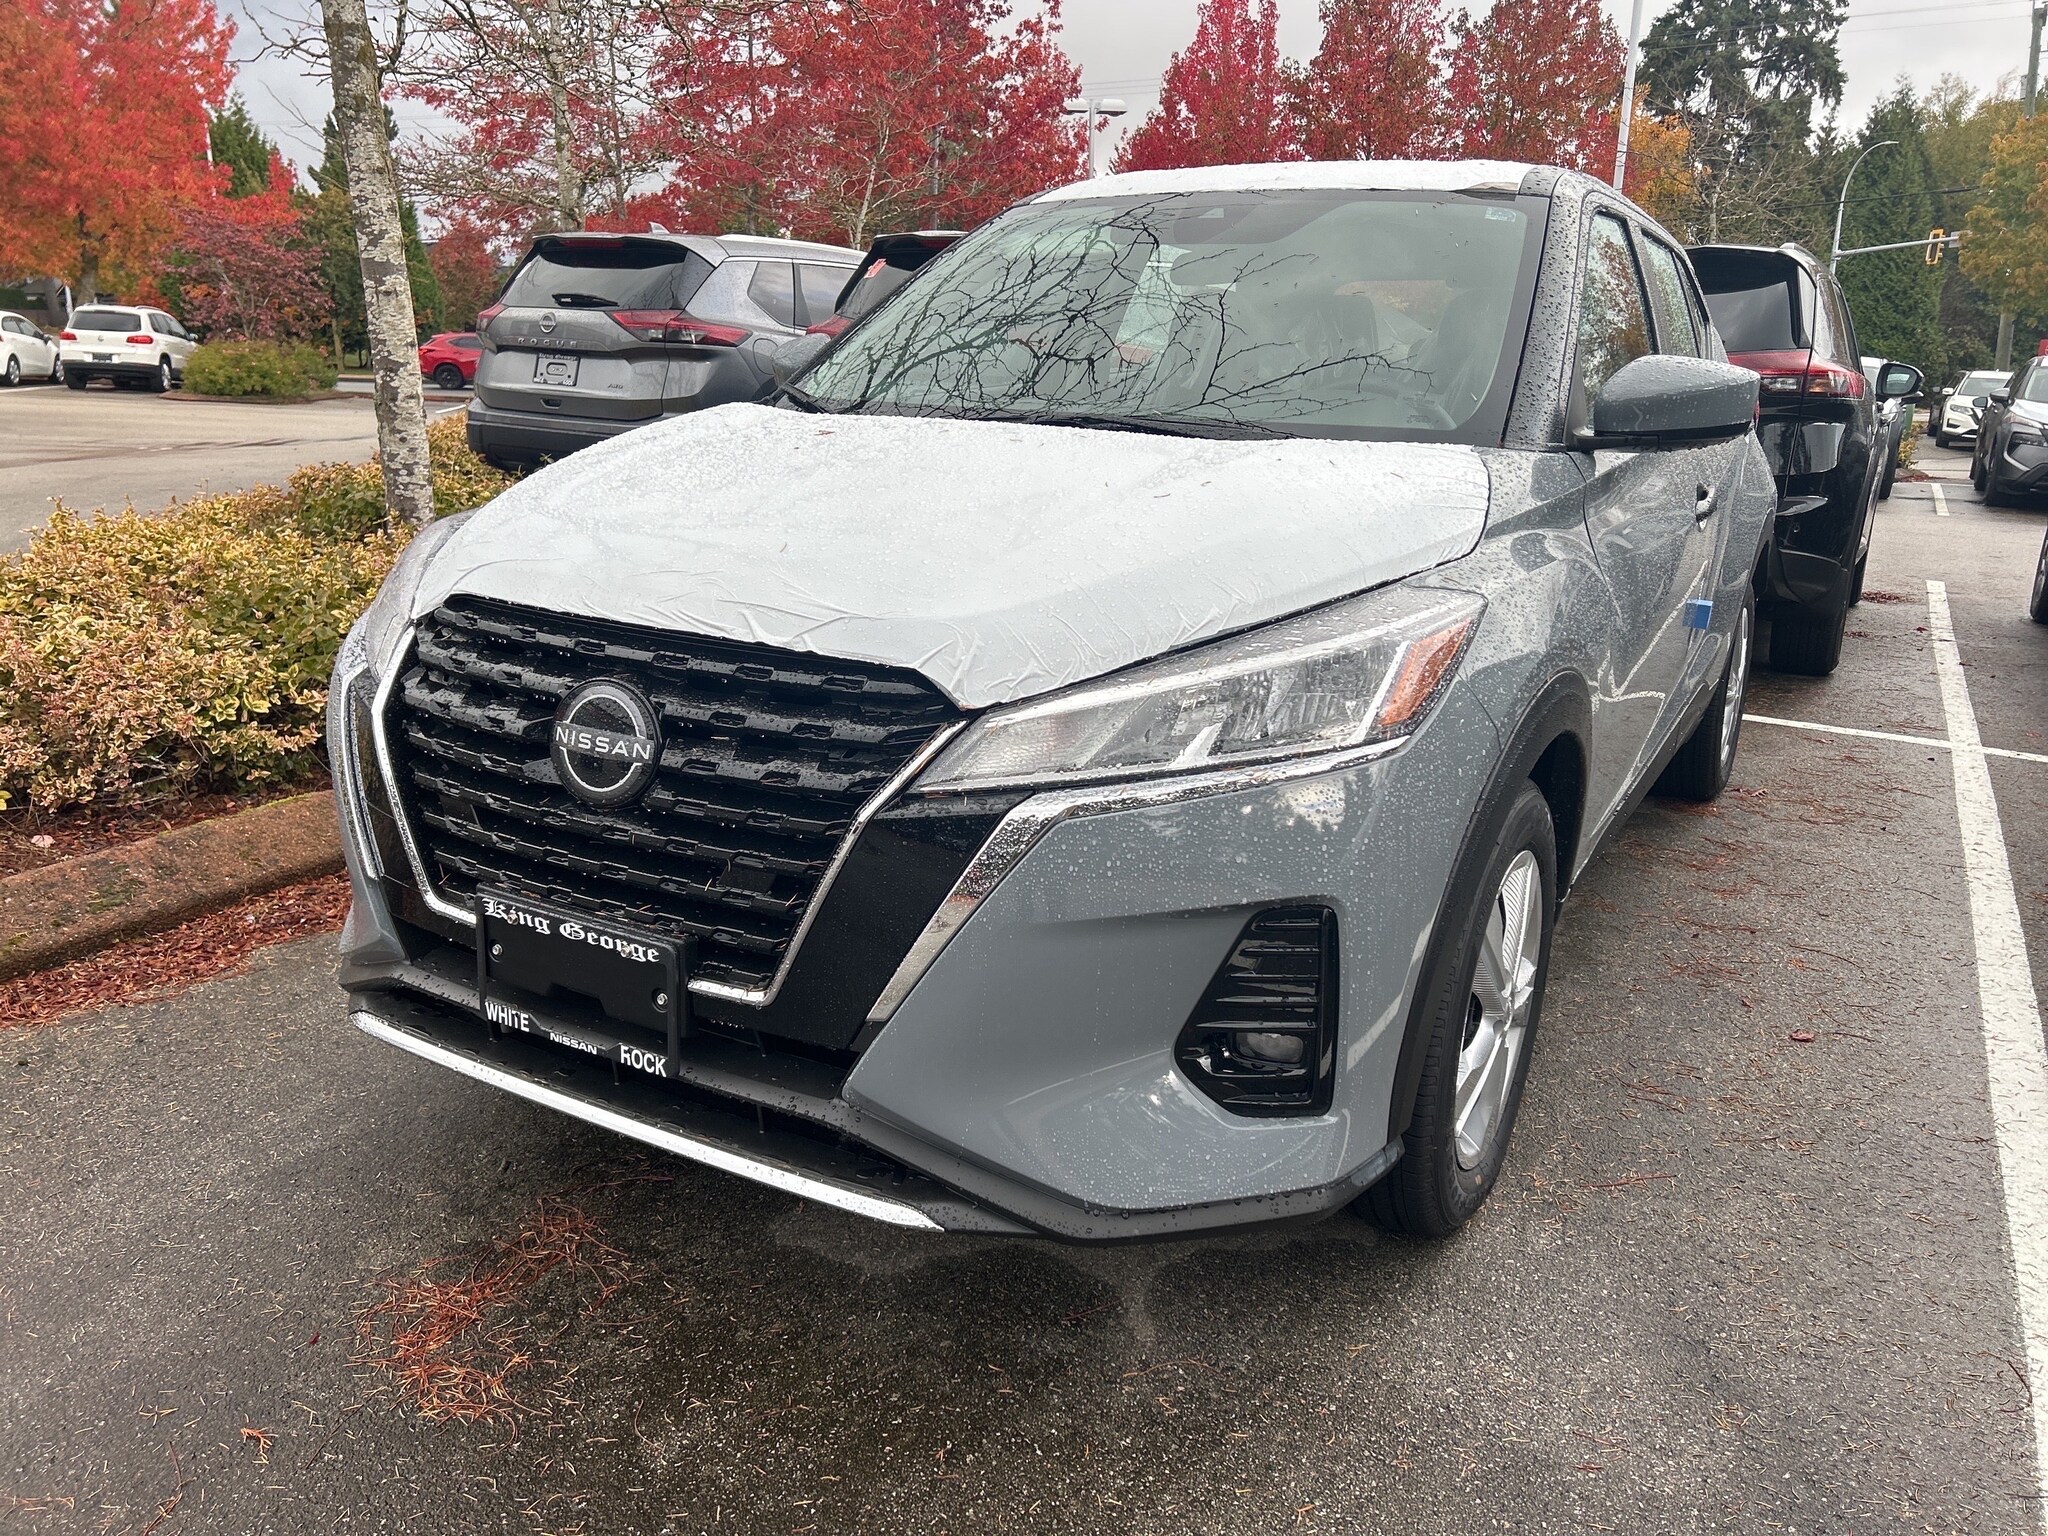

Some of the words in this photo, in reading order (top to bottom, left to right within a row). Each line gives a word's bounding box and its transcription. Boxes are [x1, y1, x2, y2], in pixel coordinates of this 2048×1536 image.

[518, 337, 577, 347] ROGUE
[555, 725, 651, 760] NISSAN
[485, 1001, 530, 1032] WHITE
[550, 1032, 598, 1055] NISSAN
[620, 1045, 667, 1077] ROCK
